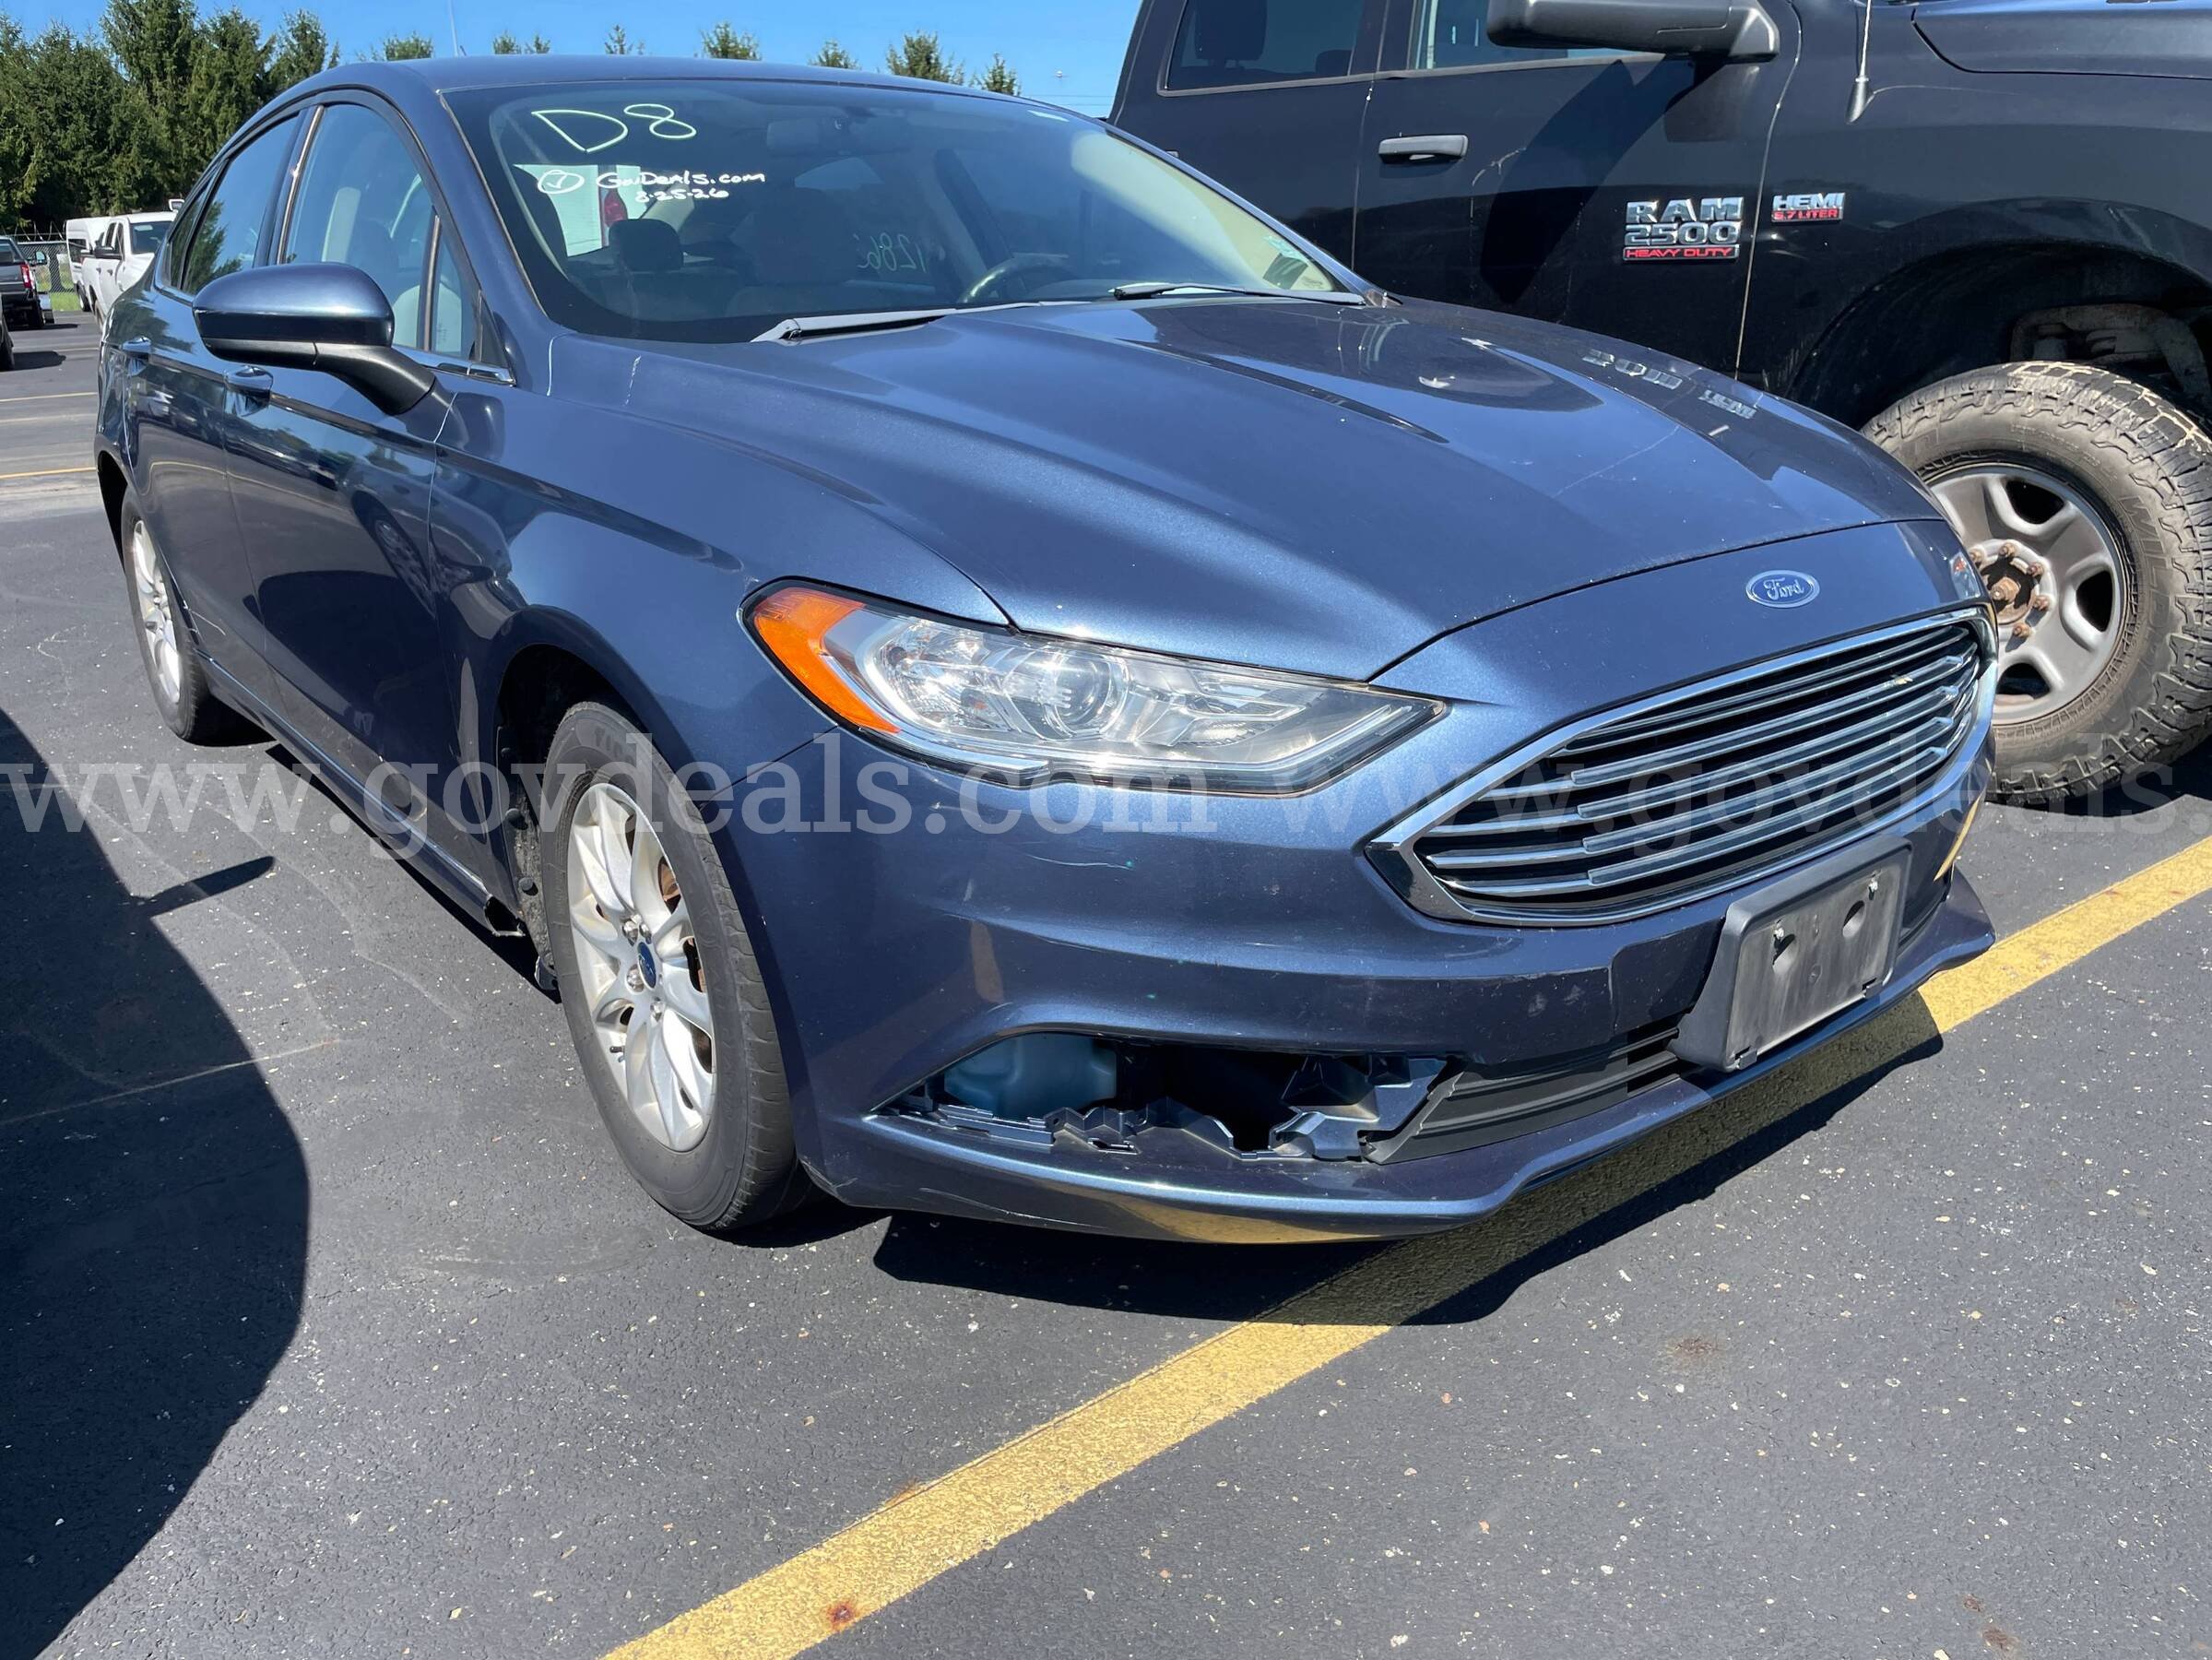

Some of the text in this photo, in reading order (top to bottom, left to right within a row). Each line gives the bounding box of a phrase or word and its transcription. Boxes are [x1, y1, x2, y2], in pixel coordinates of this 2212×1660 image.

[531, 103, 697, 152] D8
[1626, 196, 1744, 223] RAM
[1772, 192, 1845, 210] HEMI
[1773, 208, 1839, 220] 5.7 LITER
[1624, 220, 1743, 246] 2500
[1625, 246, 1733, 259] HEAVY DUTY
[1763, 576, 1805, 601] Ford
